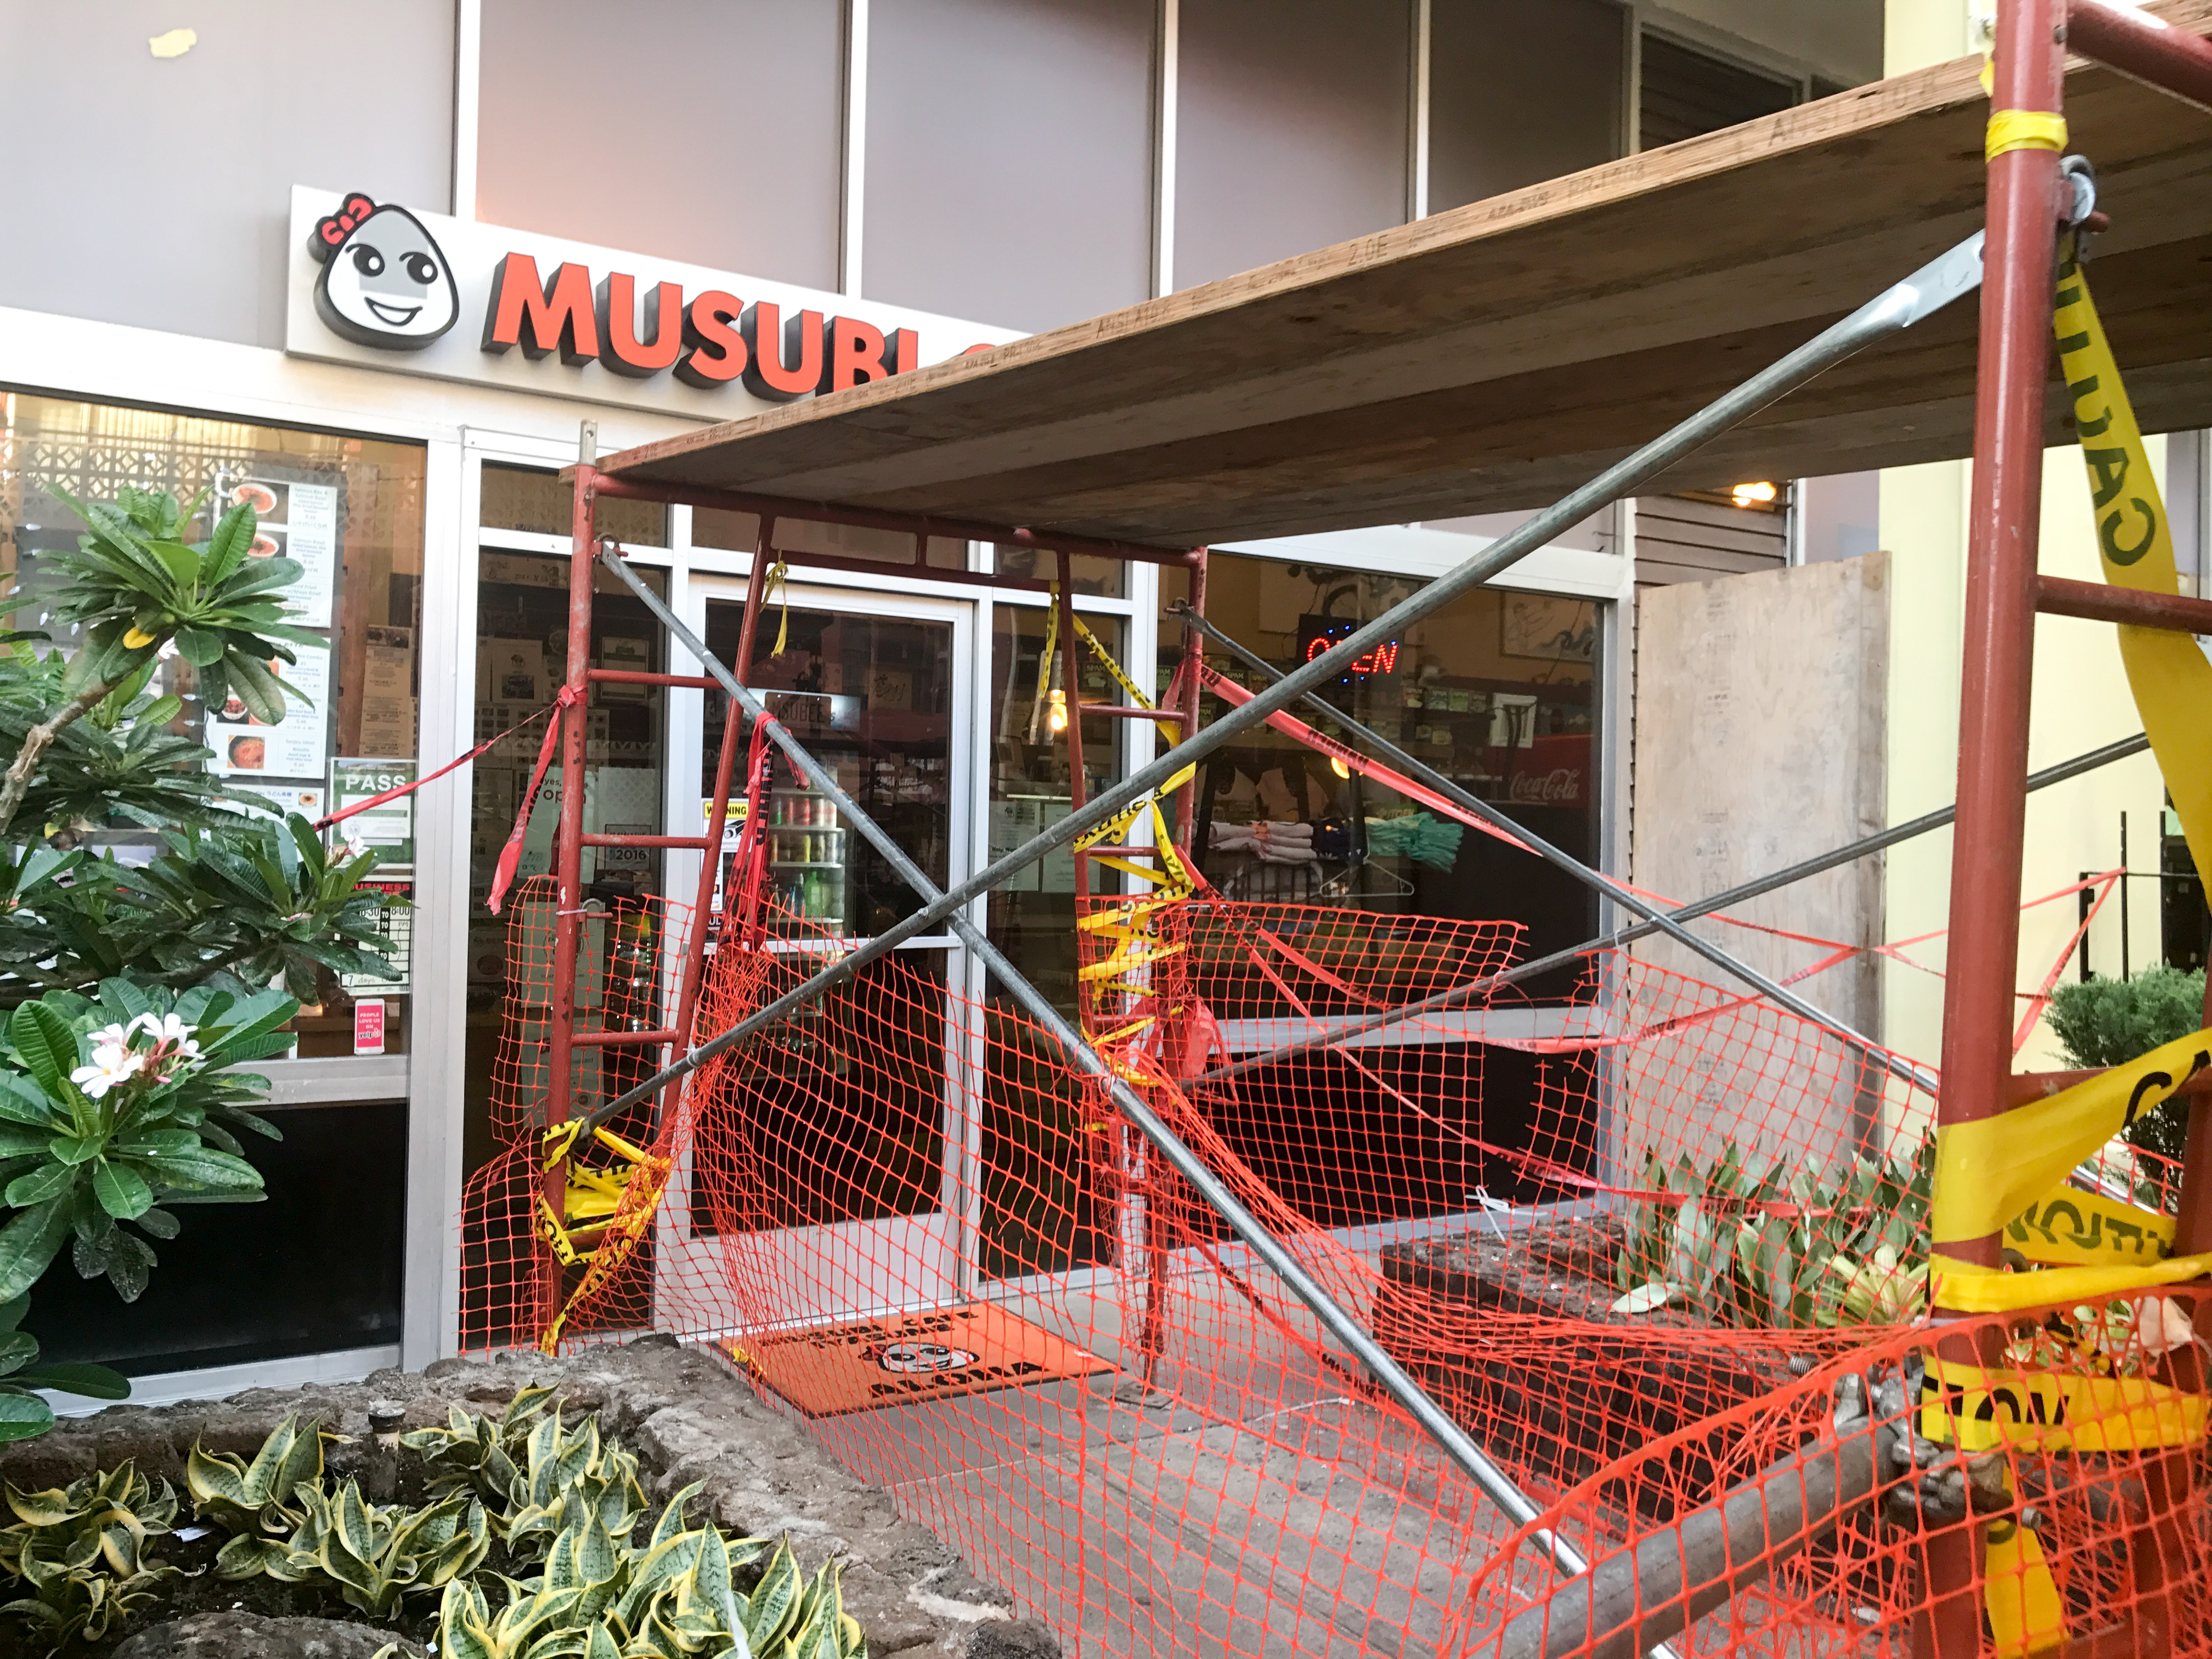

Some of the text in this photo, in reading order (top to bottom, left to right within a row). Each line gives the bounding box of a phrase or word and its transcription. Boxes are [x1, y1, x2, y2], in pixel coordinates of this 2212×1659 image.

[1306, 636, 1398, 675] OEN
[346, 774, 407, 792] PASS
[707, 805, 747, 815] WNING
[616, 849, 647, 860] 2016
[354, 883, 410, 891] USINESS
[348, 975, 375, 985] 7 days
[359, 1031, 374, 1039] yelp
